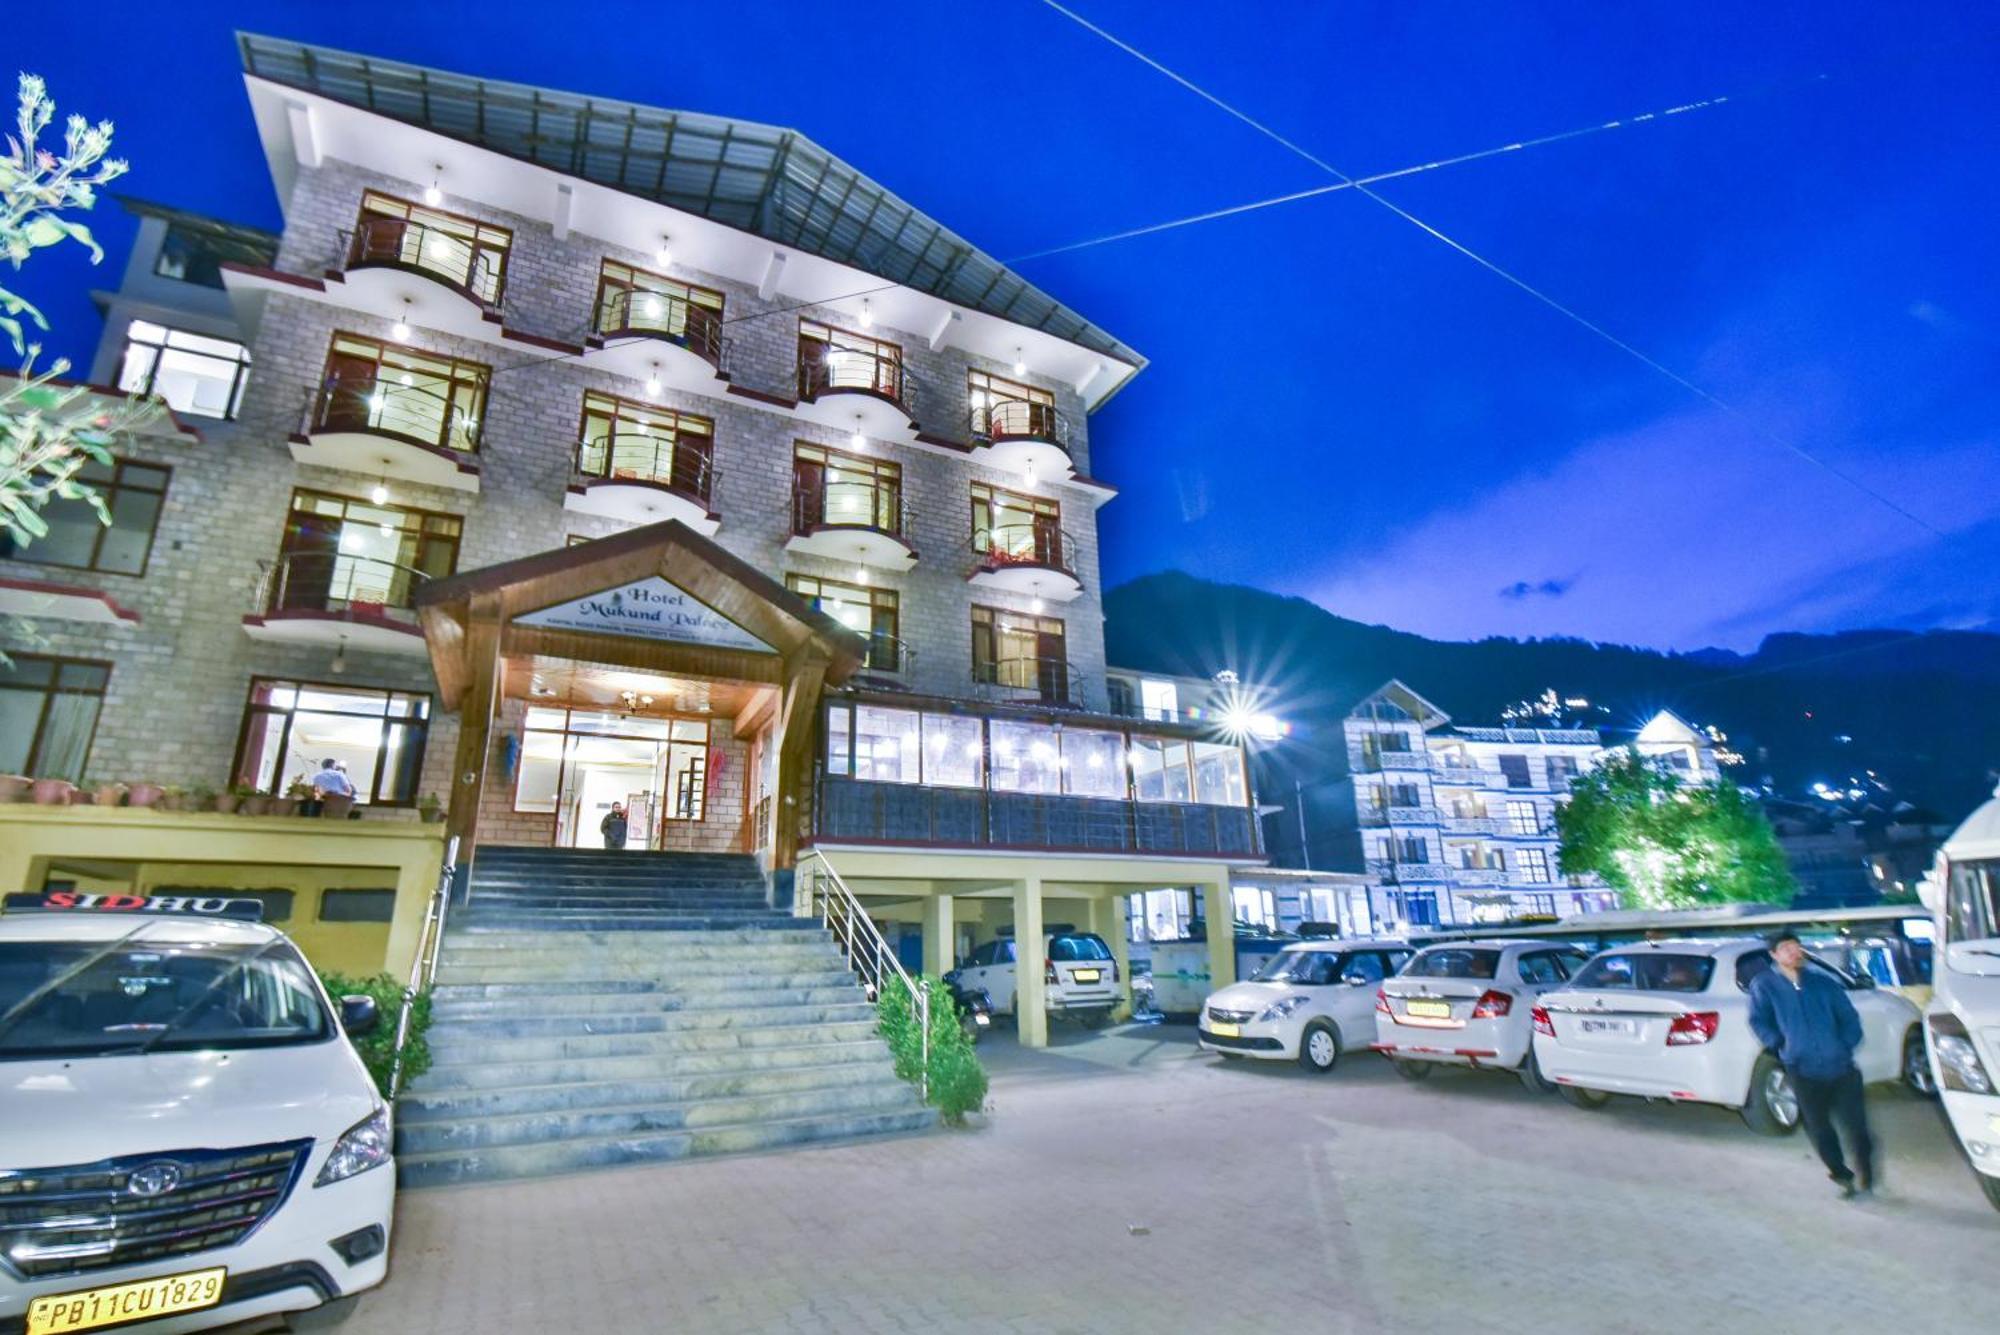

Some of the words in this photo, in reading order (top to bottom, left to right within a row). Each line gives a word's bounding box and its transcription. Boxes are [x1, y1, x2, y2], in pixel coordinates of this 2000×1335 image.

[627, 588, 684, 606] Hotel
[579, 600, 661, 621] Mukund
[44, 892, 229, 912] SIDHU
[50, 1278, 217, 1327] PB11CU1829
